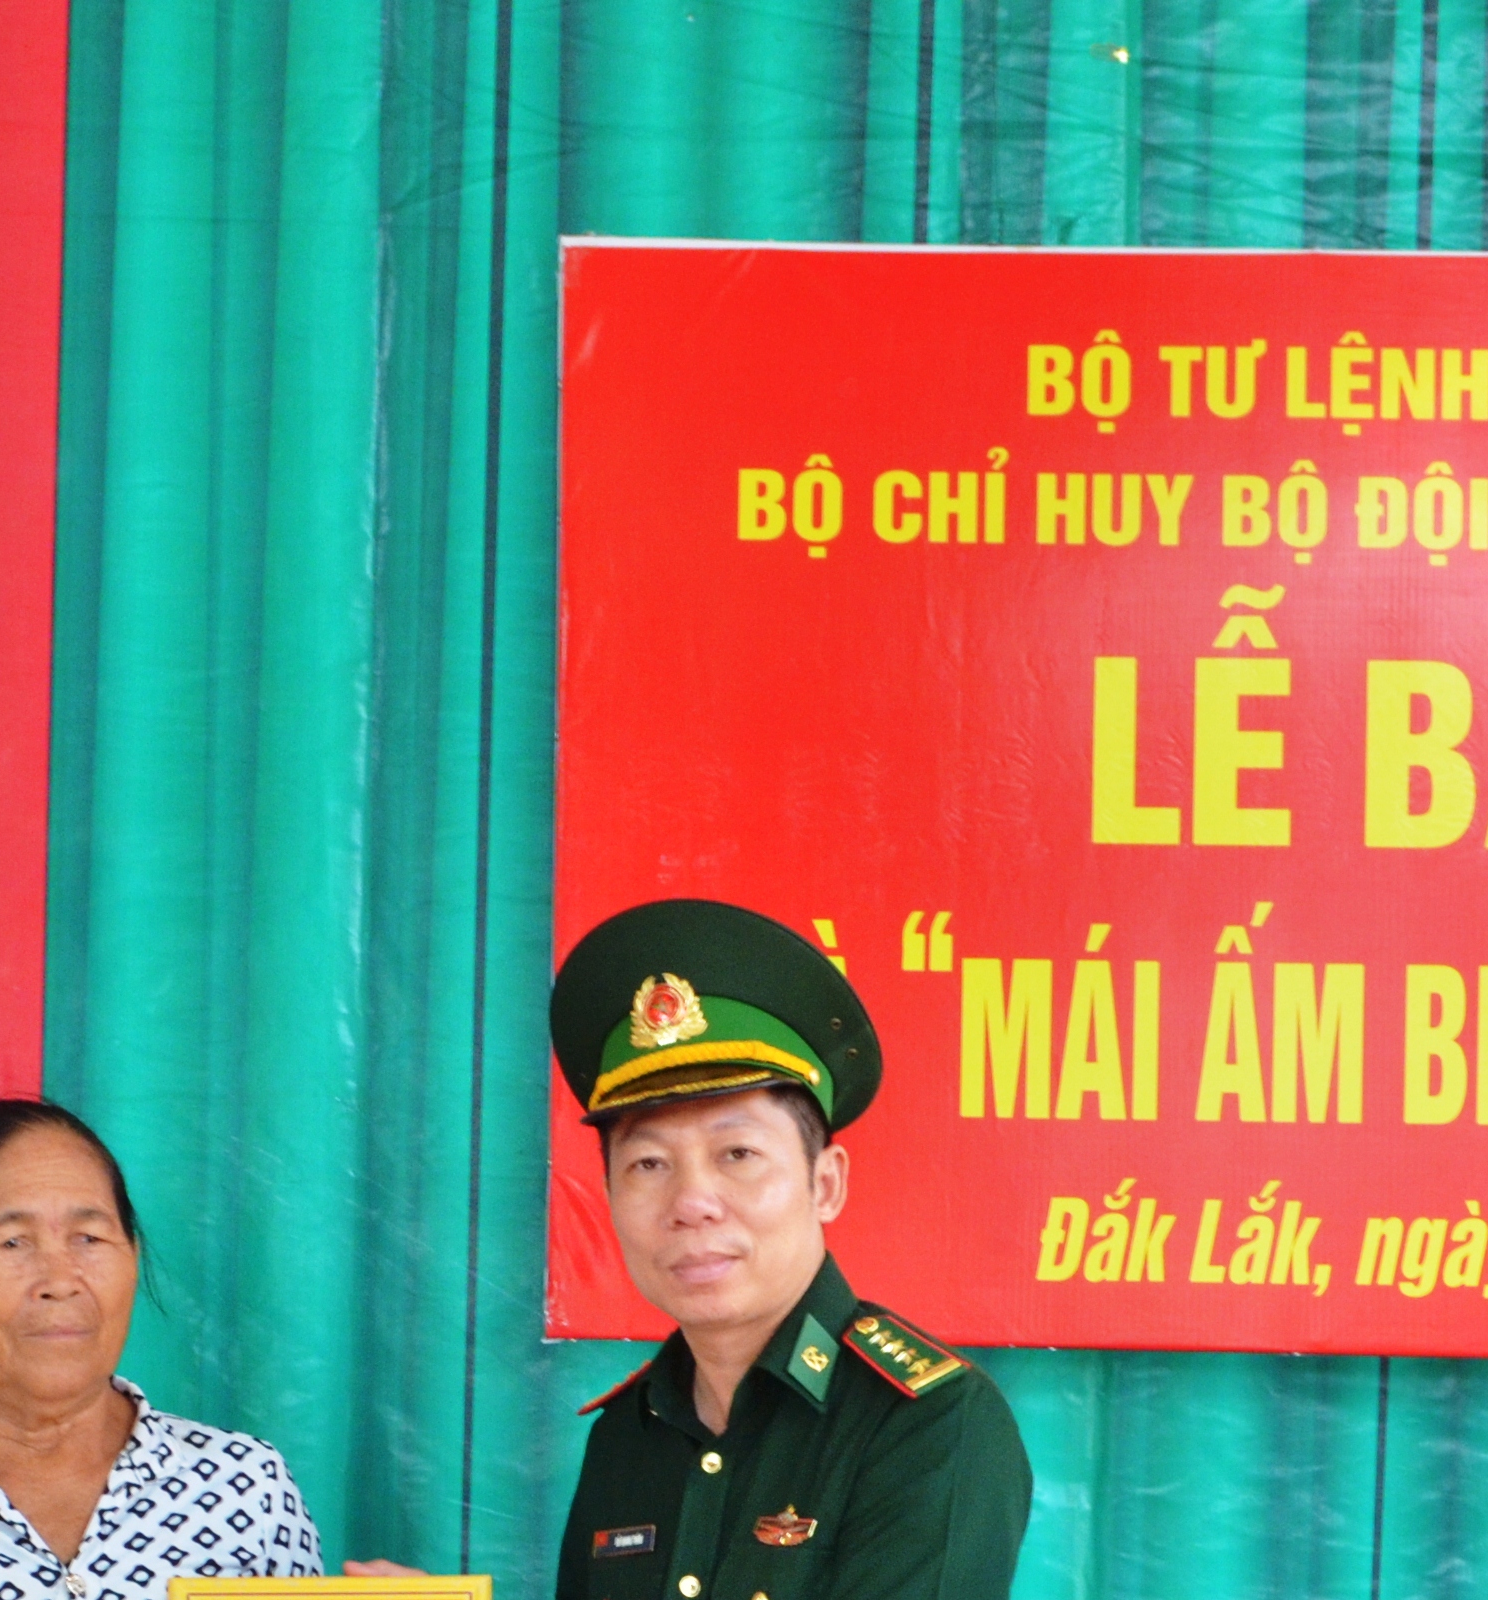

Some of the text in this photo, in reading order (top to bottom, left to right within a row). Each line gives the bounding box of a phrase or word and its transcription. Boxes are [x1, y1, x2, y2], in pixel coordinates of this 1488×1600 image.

[1027, 330, 1131, 433] BỘ
[1159, 339, 1267, 419] TƯ
[738, 454, 842, 558] BỘ
[873, 447, 1009, 543] CHỈ
[1036, 473, 1194, 547] HUY
[1221, 459, 1329, 565] BỘ
[1091, 583, 1292, 847] LỄ
[902, 911, 1161, 1121] “MÁI
[1194, 901, 1366, 1124] ẤM
[1035, 1177, 1177, 1283] Đắk
[1188, 1179, 1332, 1297] Lắk,
